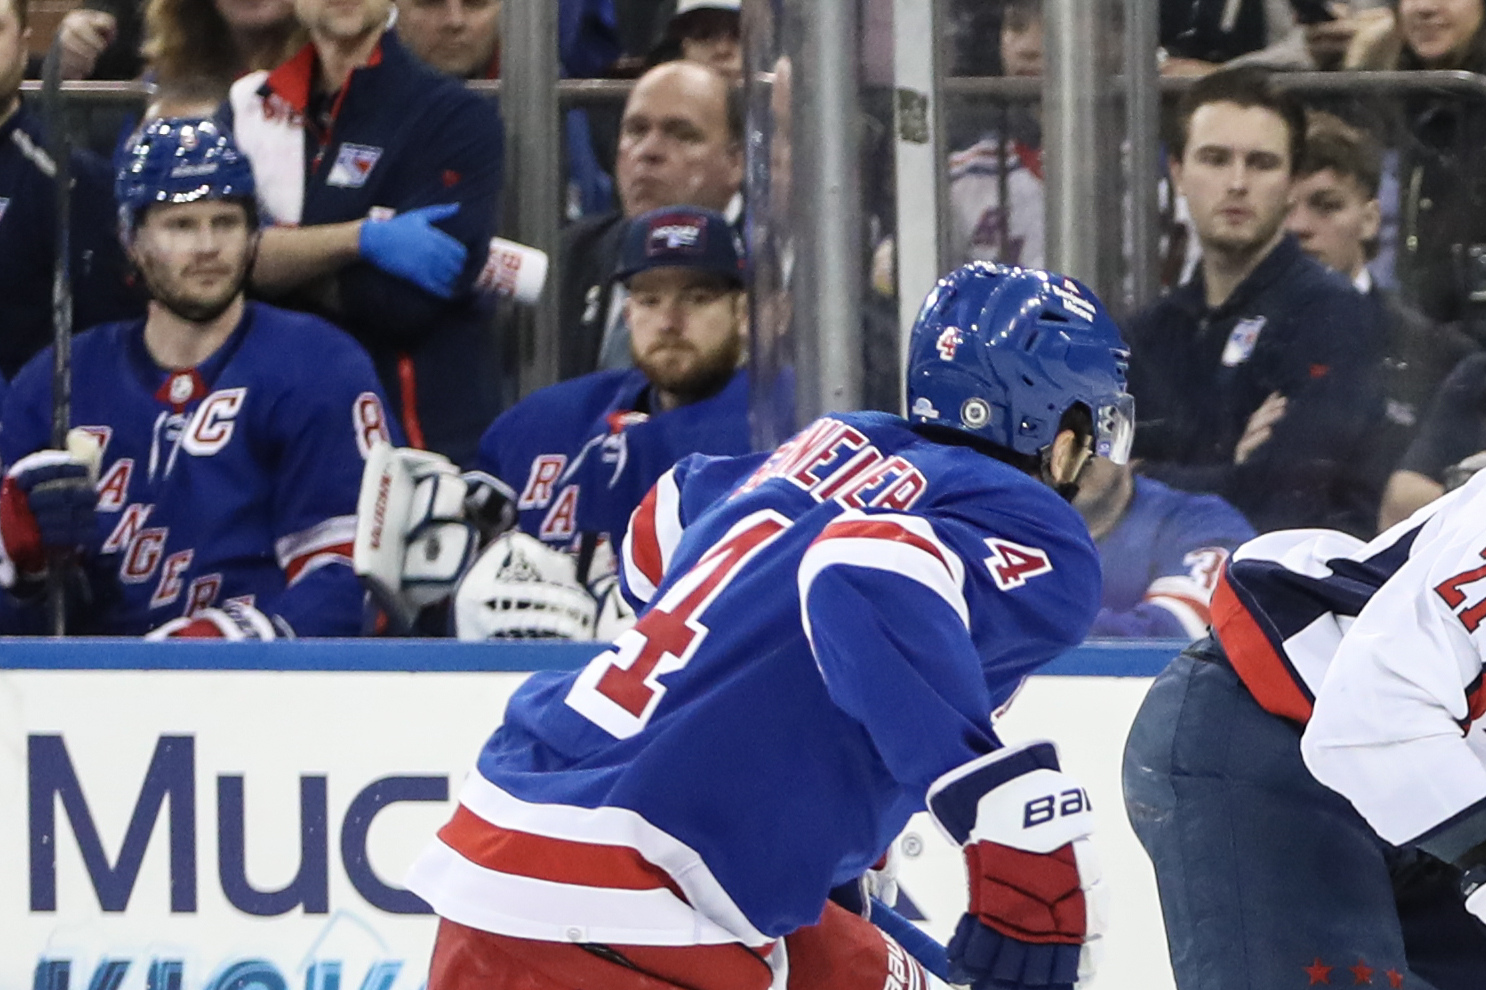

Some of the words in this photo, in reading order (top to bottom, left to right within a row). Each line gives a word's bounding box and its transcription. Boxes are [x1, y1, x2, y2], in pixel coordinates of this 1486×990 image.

[936, 326, 963, 361] 4
[183, 387, 248, 456] C
[68, 425, 256, 620] ANGER
[984, 537, 1053, 591] 4
[564, 508, 794, 740] 4
